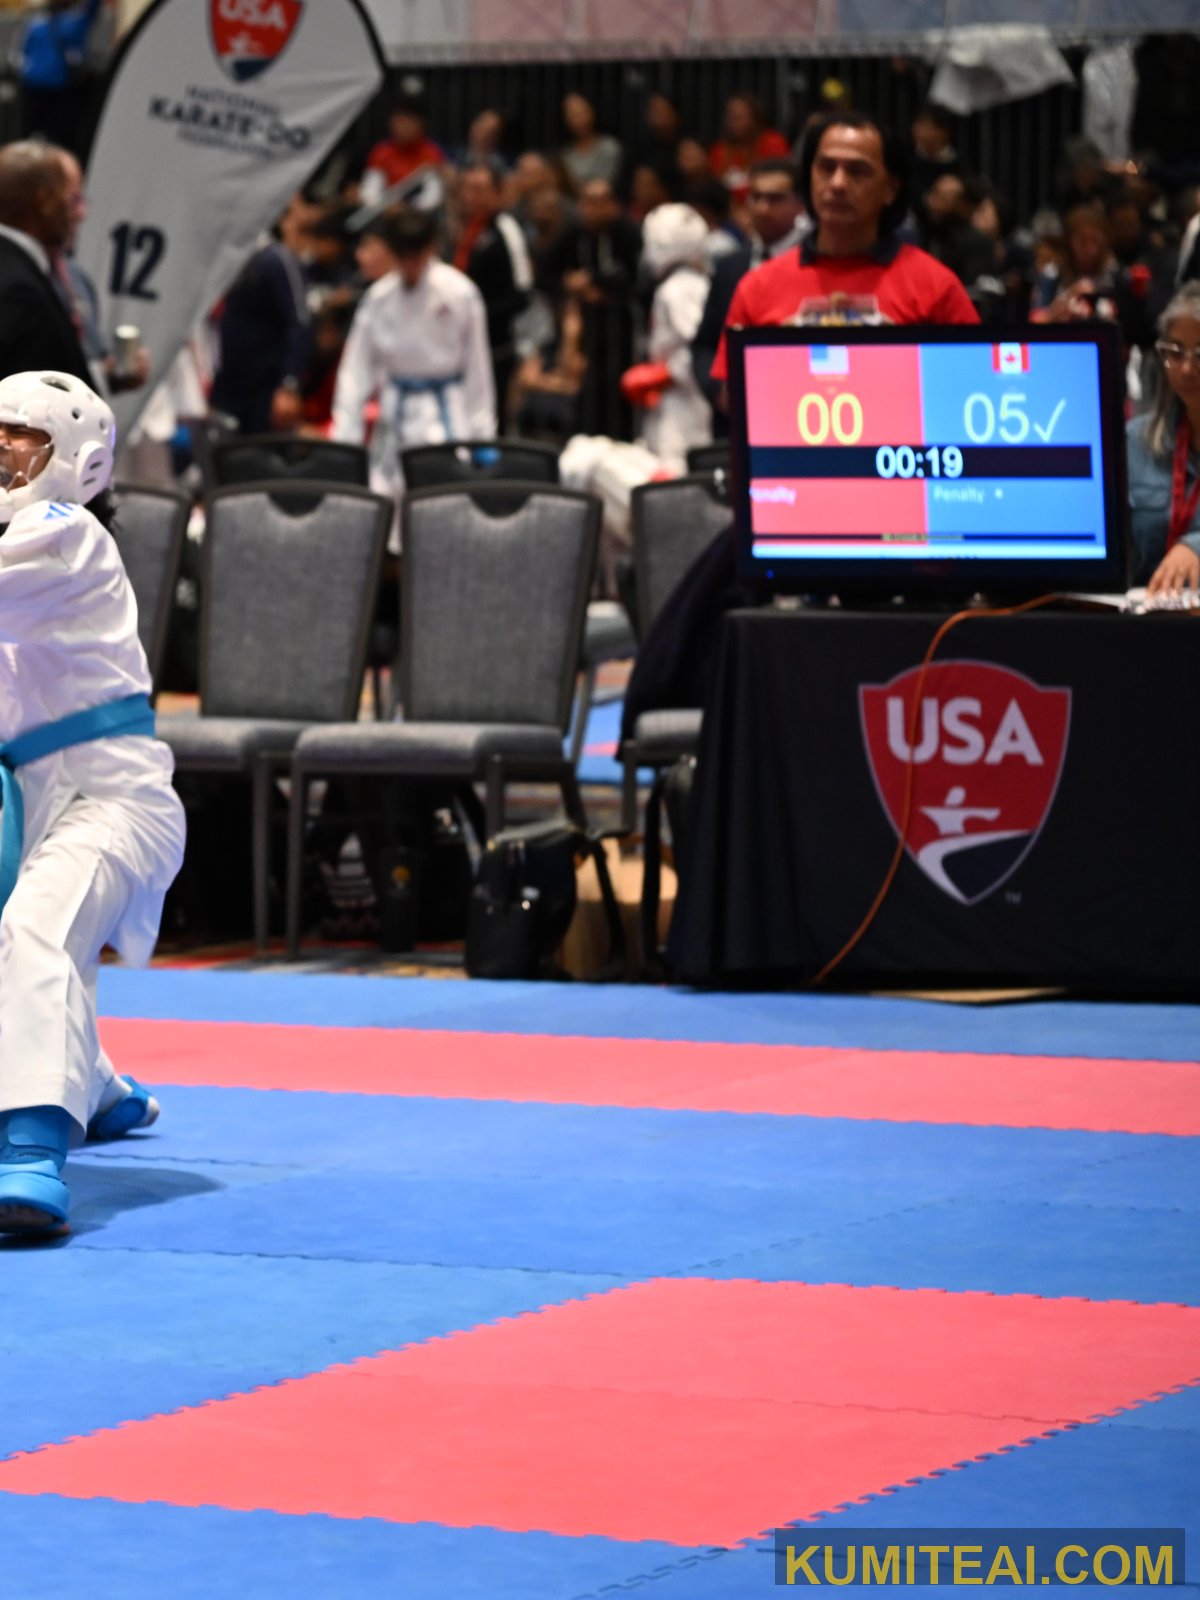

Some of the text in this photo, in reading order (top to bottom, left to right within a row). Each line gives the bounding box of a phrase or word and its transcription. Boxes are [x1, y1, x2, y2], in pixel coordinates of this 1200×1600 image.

[109, 221, 167, 302] 12
[798, 393, 863, 445] 00
[875, 445, 964, 479] 00:19
[933, 485, 984, 505] Penalty
[886, 696, 1044, 766] USA
